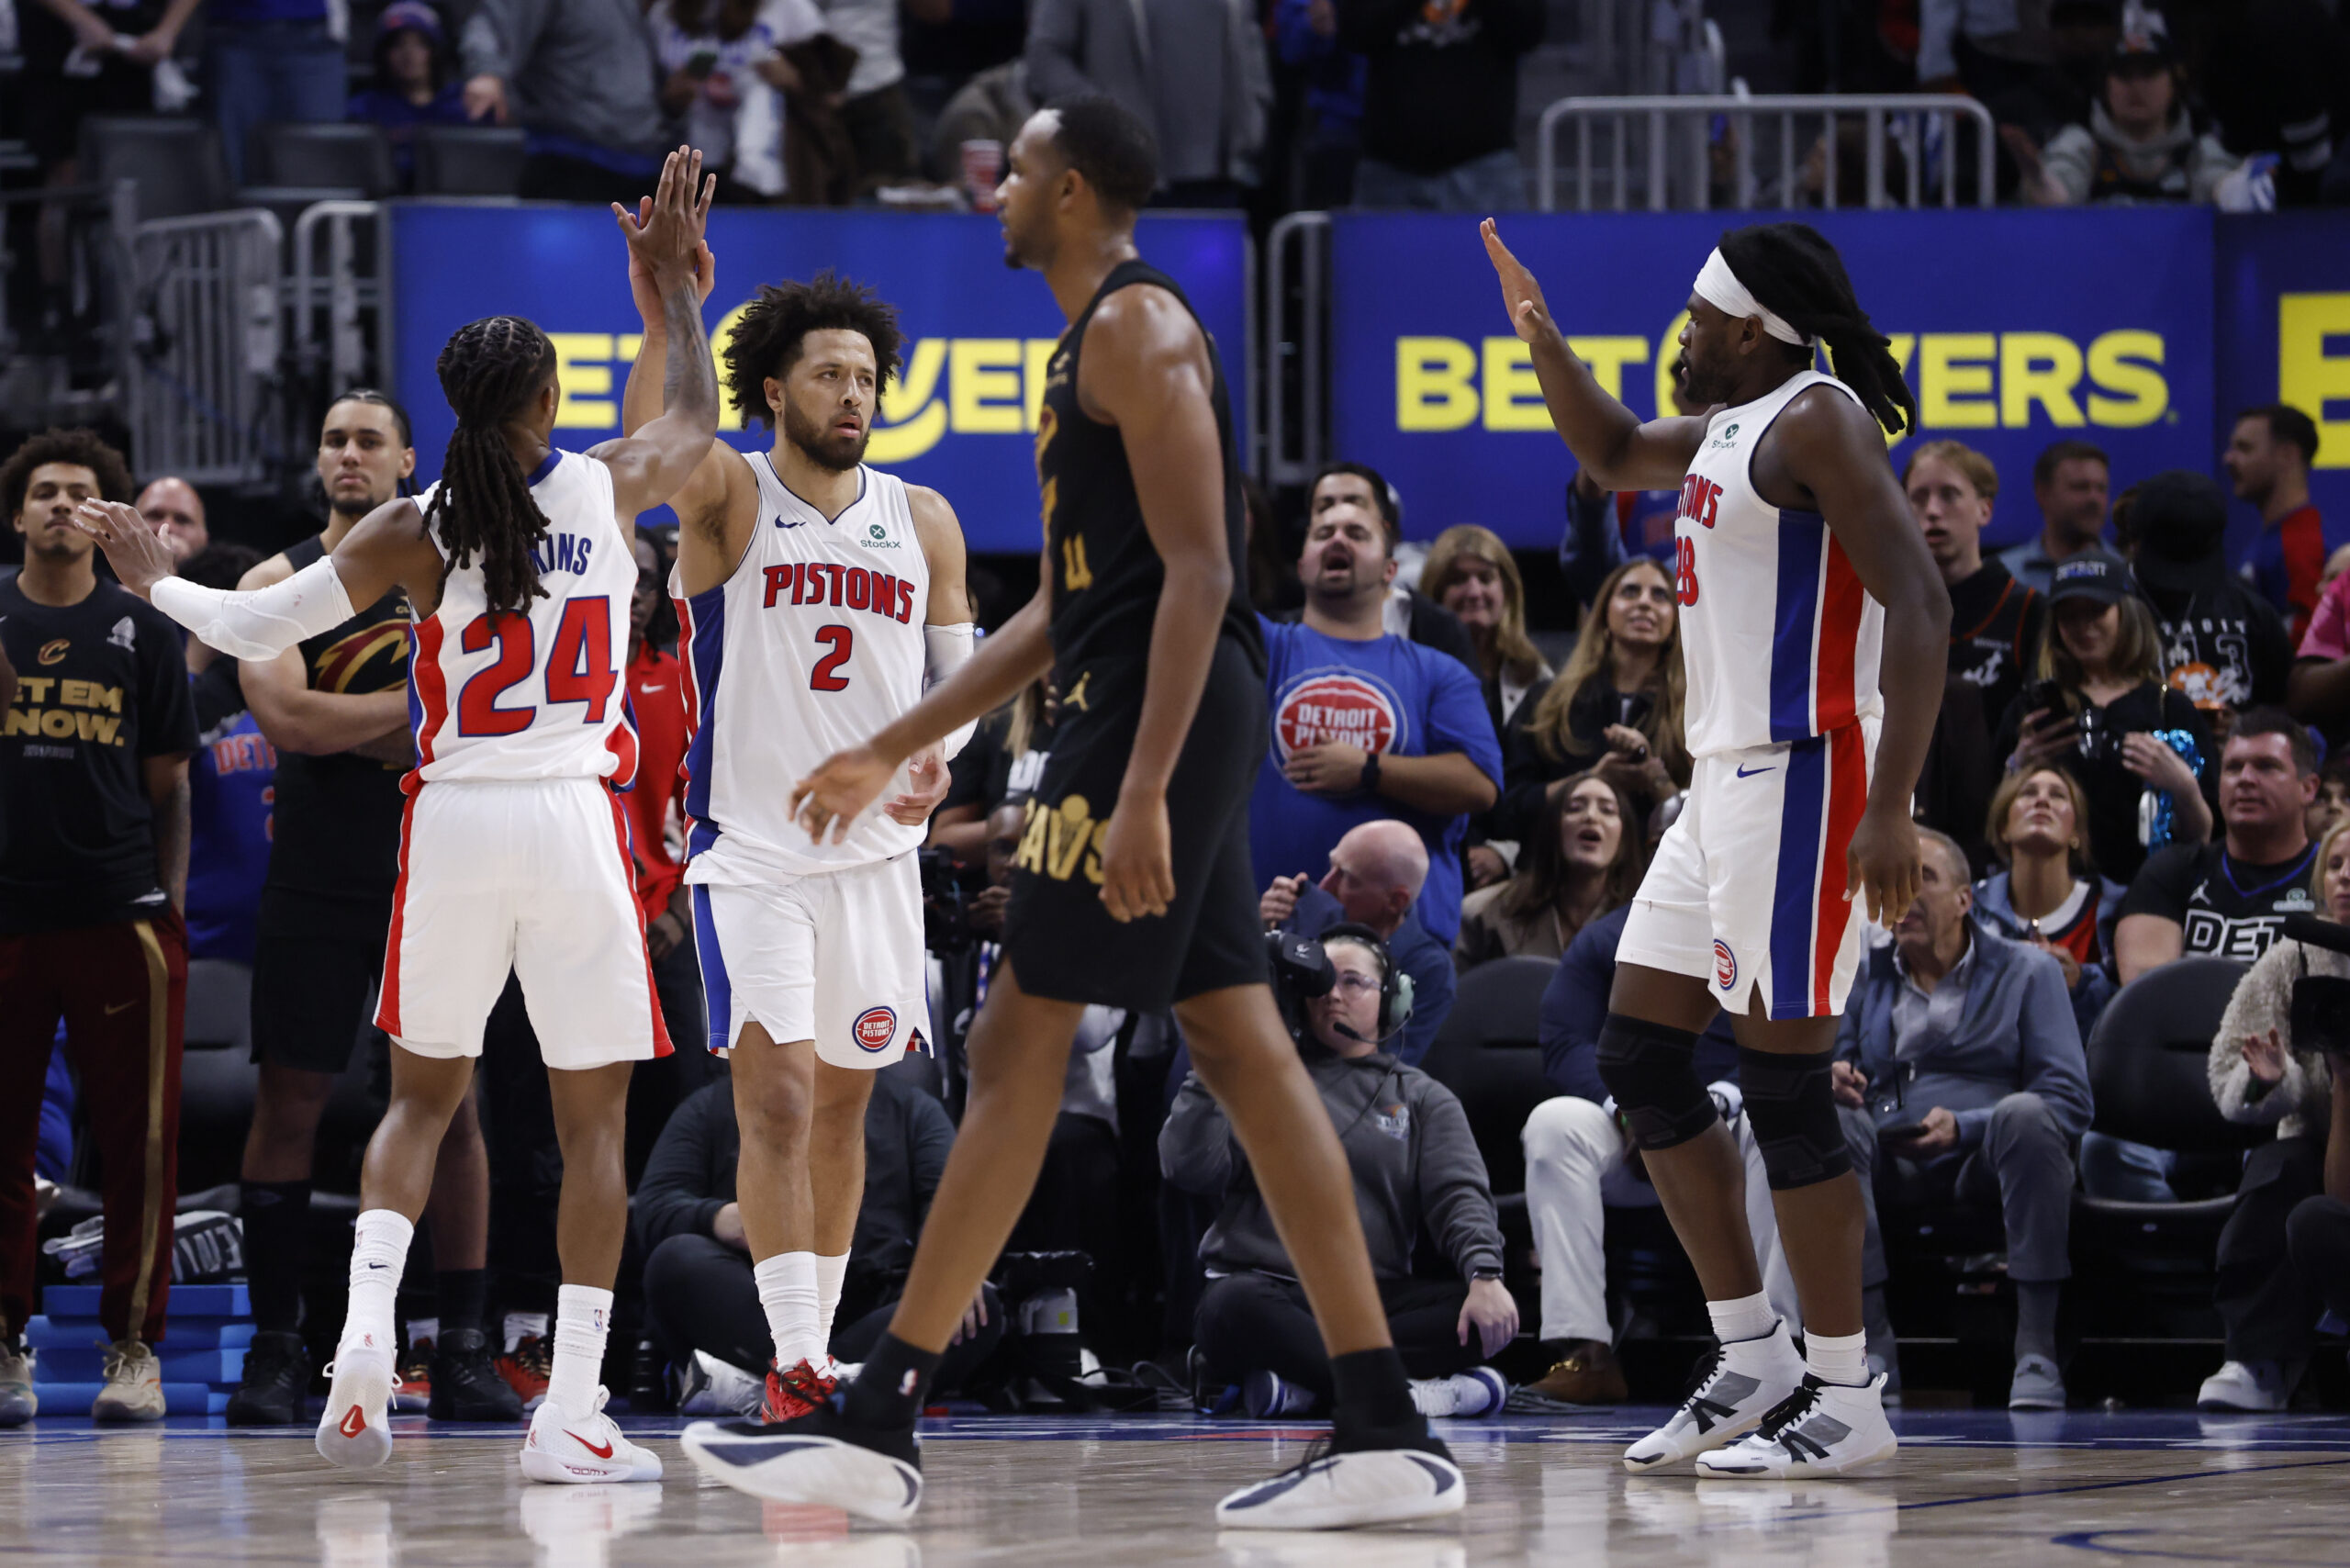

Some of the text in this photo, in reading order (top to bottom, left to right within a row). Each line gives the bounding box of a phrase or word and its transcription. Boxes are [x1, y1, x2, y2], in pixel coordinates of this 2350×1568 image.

[860, 539, 901, 549] StockX
[763, 563, 915, 625] PISTONS
[458, 594, 619, 737] 24
[810, 624, 854, 692] 2
[60, 678, 124, 715] EM
[2, 707, 125, 747] NOW.
[1297, 702, 1378, 729] DETROIT
[862, 1027, 890, 1037] PISTONS
[863, 1019, 890, 1029] DETROIT
